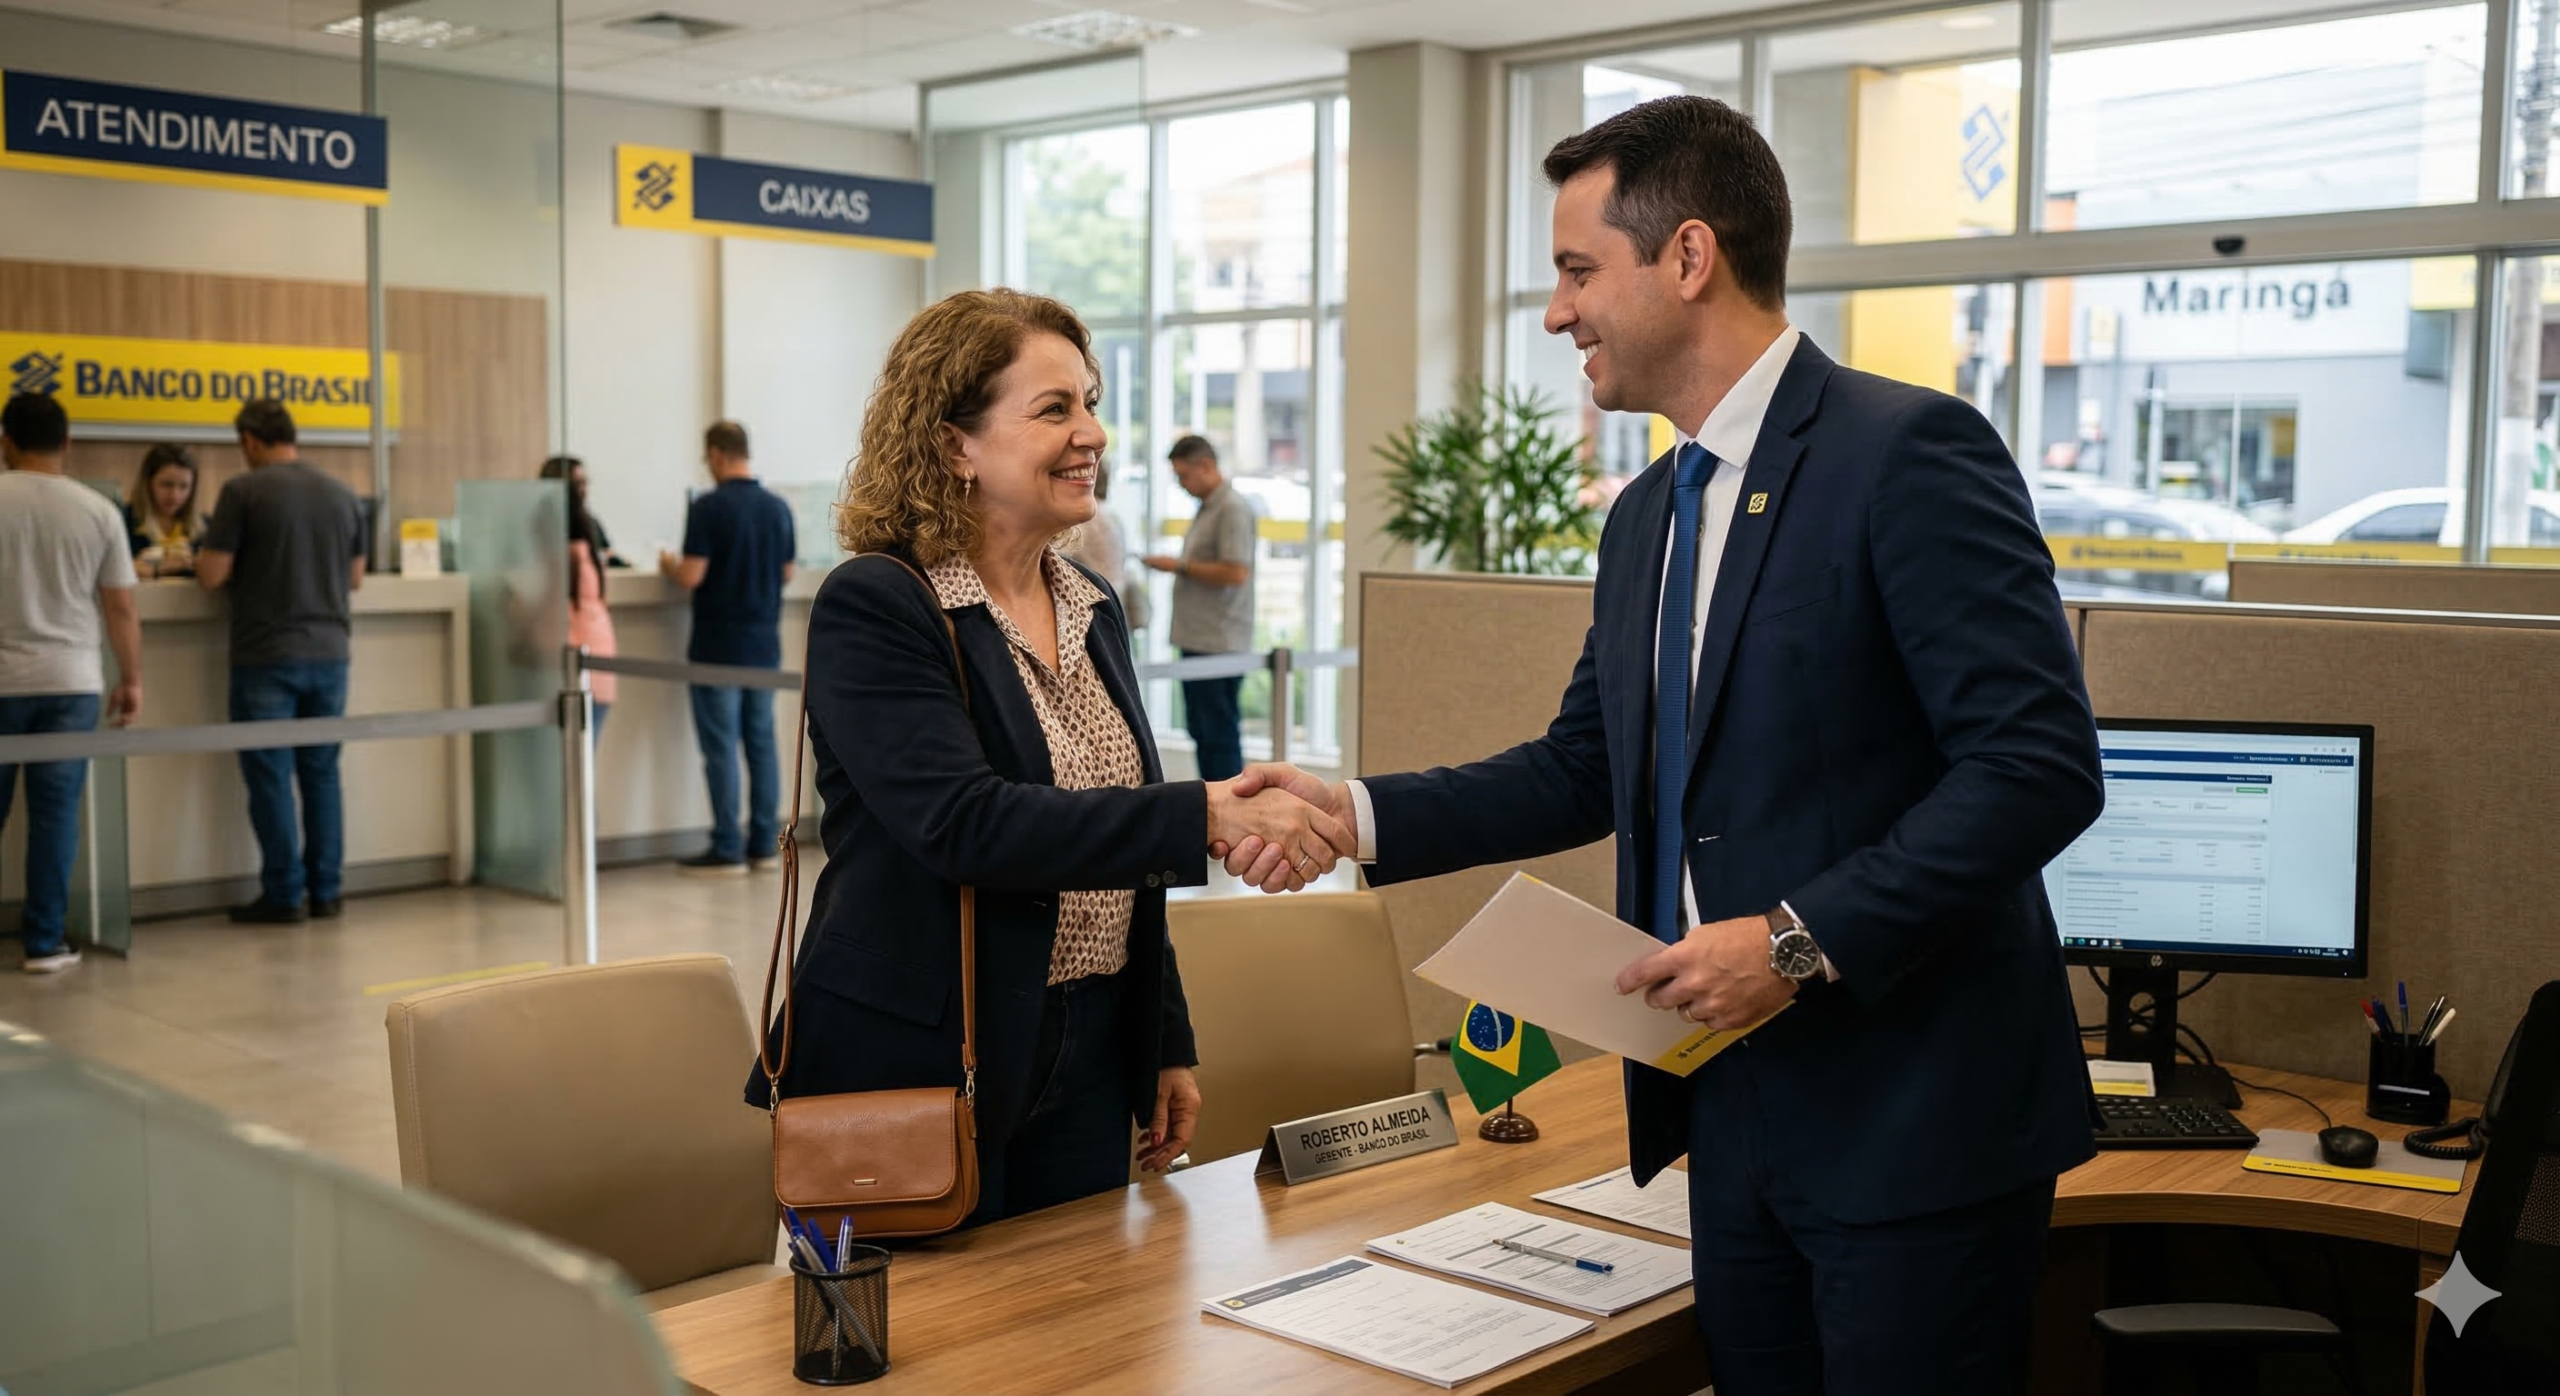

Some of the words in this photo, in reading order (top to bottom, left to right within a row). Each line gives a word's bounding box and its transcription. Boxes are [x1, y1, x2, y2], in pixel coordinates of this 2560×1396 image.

[36, 98, 357, 170] ATENDIMENTO
[759, 179, 871, 224] CAIXAS
[2143, 266, 2350, 320] Maringá
[75, 360, 202, 401] BANCO
[211, 373, 256, 401] DO
[1301, 1120, 1369, 1150] ROBERTO
[1372, 1106, 1431, 1134] ALMEIDA
[1358, 1138, 1387, 1154] BANCO
[1388, 1135, 1400, 1147] DO
[1402, 1128, 1430, 1144] BRASIL
